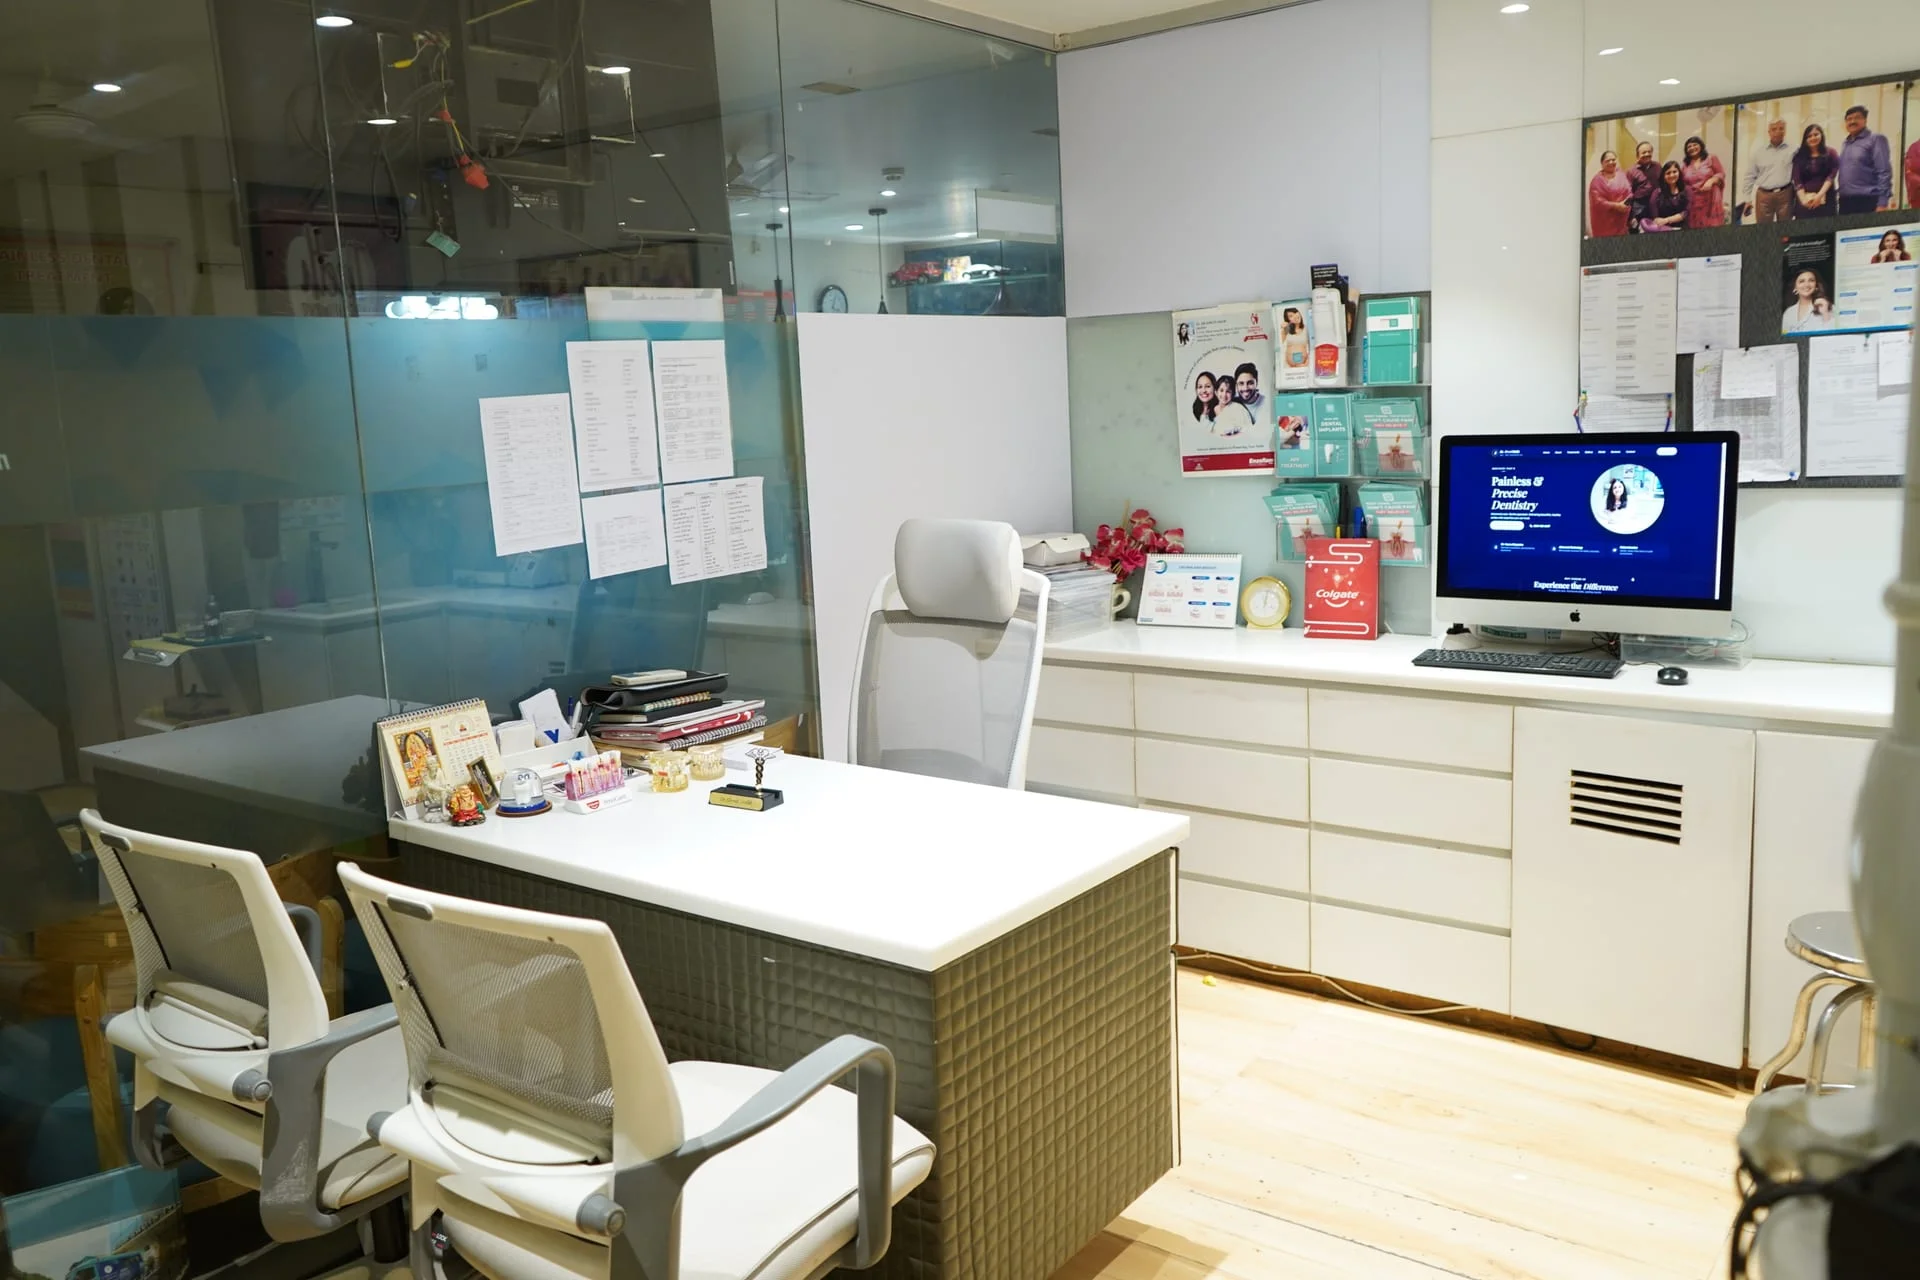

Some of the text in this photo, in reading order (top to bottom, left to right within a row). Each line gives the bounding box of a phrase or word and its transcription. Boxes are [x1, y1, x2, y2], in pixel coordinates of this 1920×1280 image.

[1491, 476, 1545, 487] Painless &
[1491, 488, 1528, 498] Precise
[1491, 500, 1539, 512] Dentistry
[1533, 581, 1619, 591] Experience the Difference
[1315, 589, 1360, 600] Colgate
